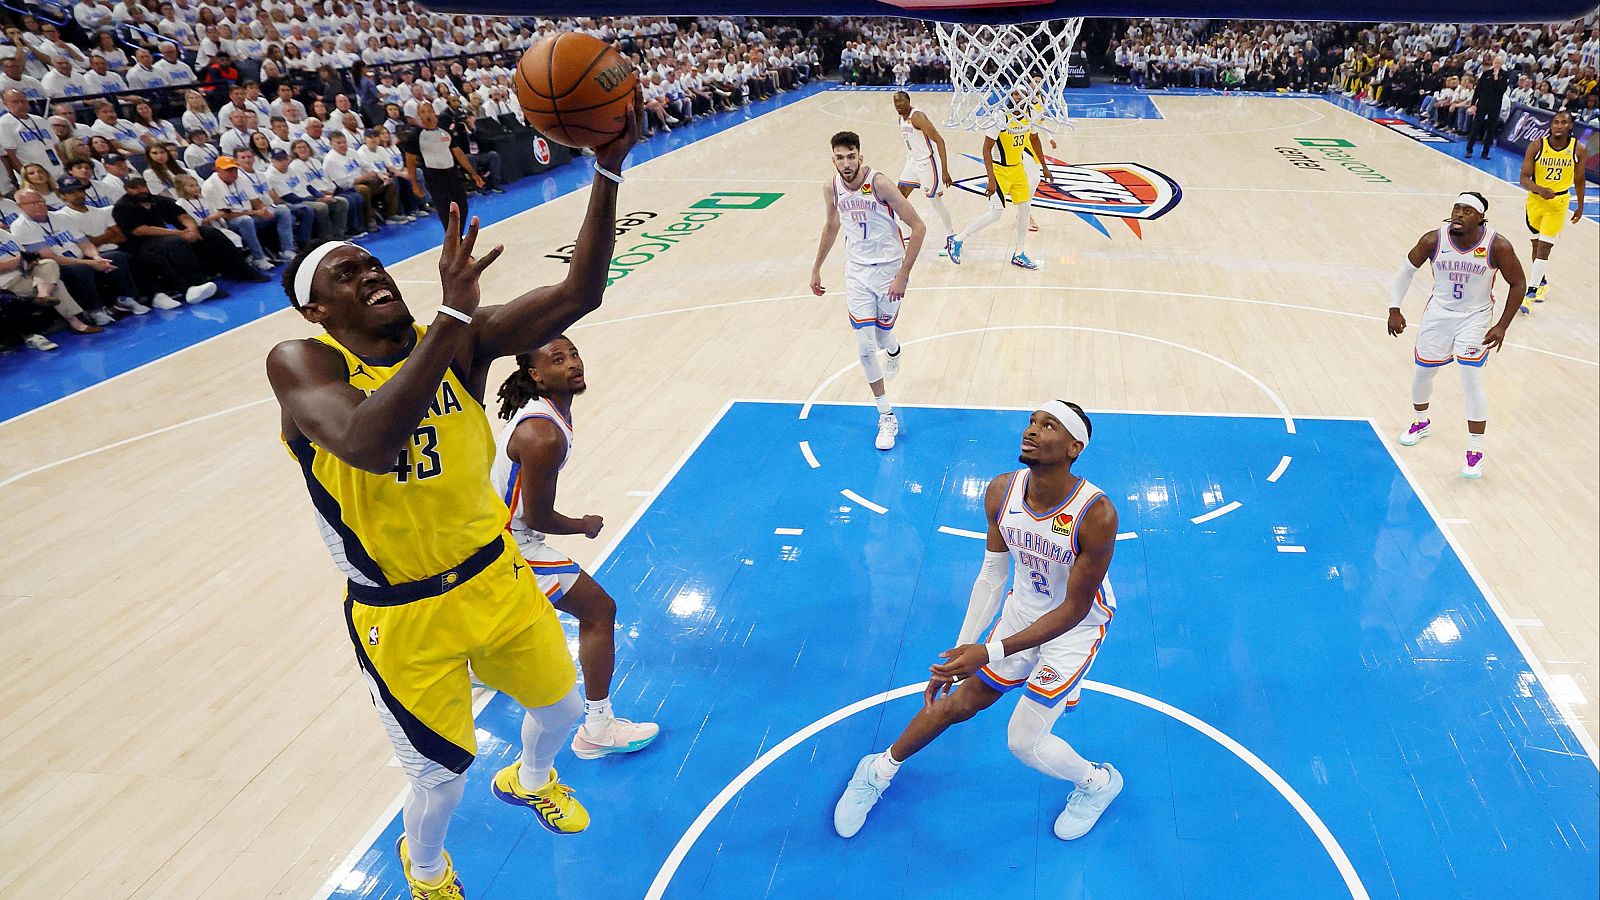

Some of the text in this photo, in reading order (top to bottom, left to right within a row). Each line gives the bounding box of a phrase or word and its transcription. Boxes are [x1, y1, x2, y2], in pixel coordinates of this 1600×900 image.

[1012, 134, 1025, 147] 33
[1274, 146, 1327, 172] center
[1307, 147, 1393, 183] paycom
[1540, 157, 1572, 167] INDIANA
[1545, 167, 1563, 181] 23
[851, 211, 867, 222] CITY
[859, 222, 867, 240] 7
[1436, 260, 1487, 276] OKLAHOMA
[1449, 271, 1471, 284] CITY
[1452, 283, 1465, 300] 5
[391, 425, 443, 483] 43
[1000, 526, 1074, 565] OKLAHOMA
[1019, 551, 1051, 575] CITY
[1030, 571, 1053, 599] 2
